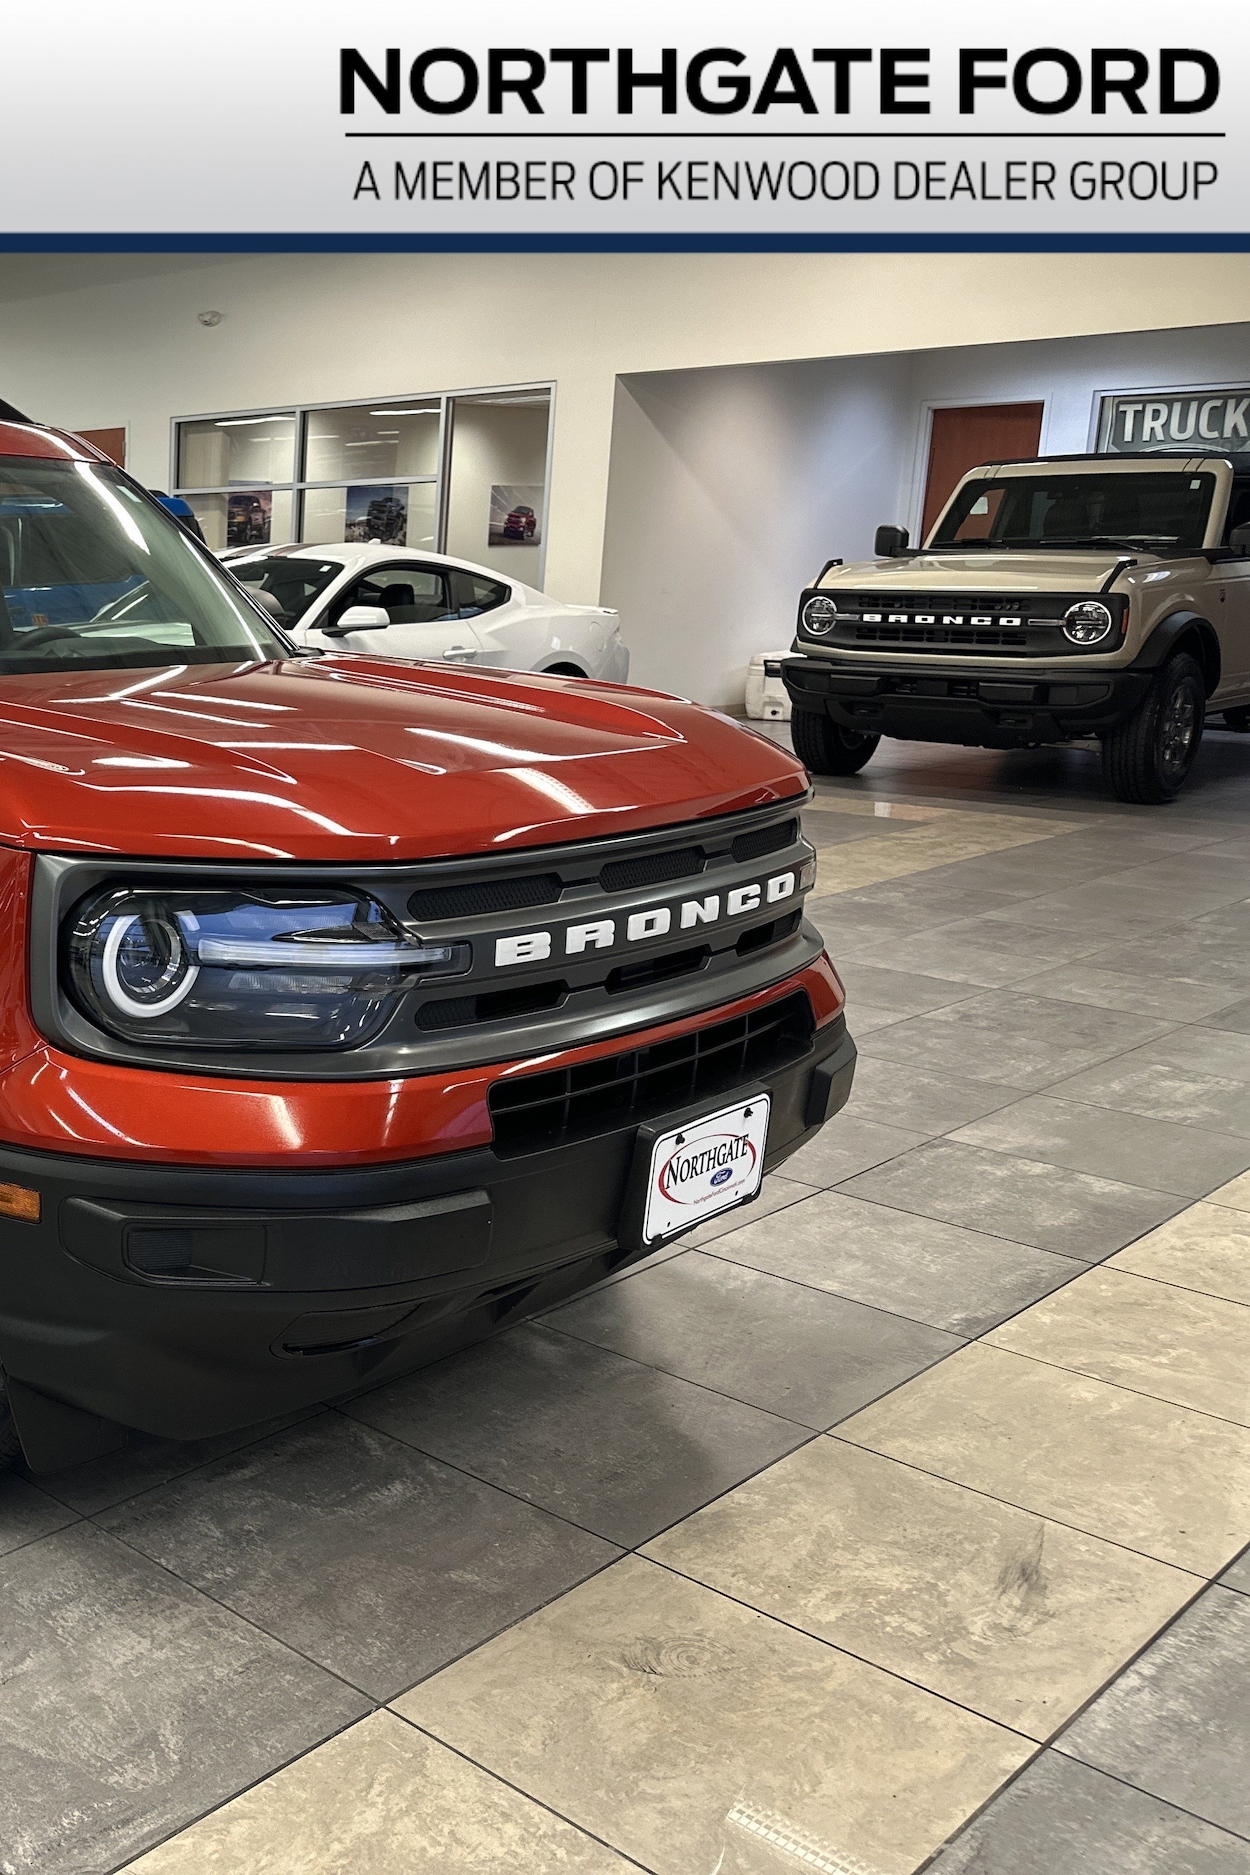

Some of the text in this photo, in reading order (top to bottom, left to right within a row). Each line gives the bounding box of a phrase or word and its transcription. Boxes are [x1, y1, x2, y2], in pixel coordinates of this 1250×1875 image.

[862, 613, 1022, 627] BRONCO
[494, 871, 796, 968] BRONCO
[665, 1133, 749, 1189] NORTHGATE
[714, 1169, 730, 1185] Ford
